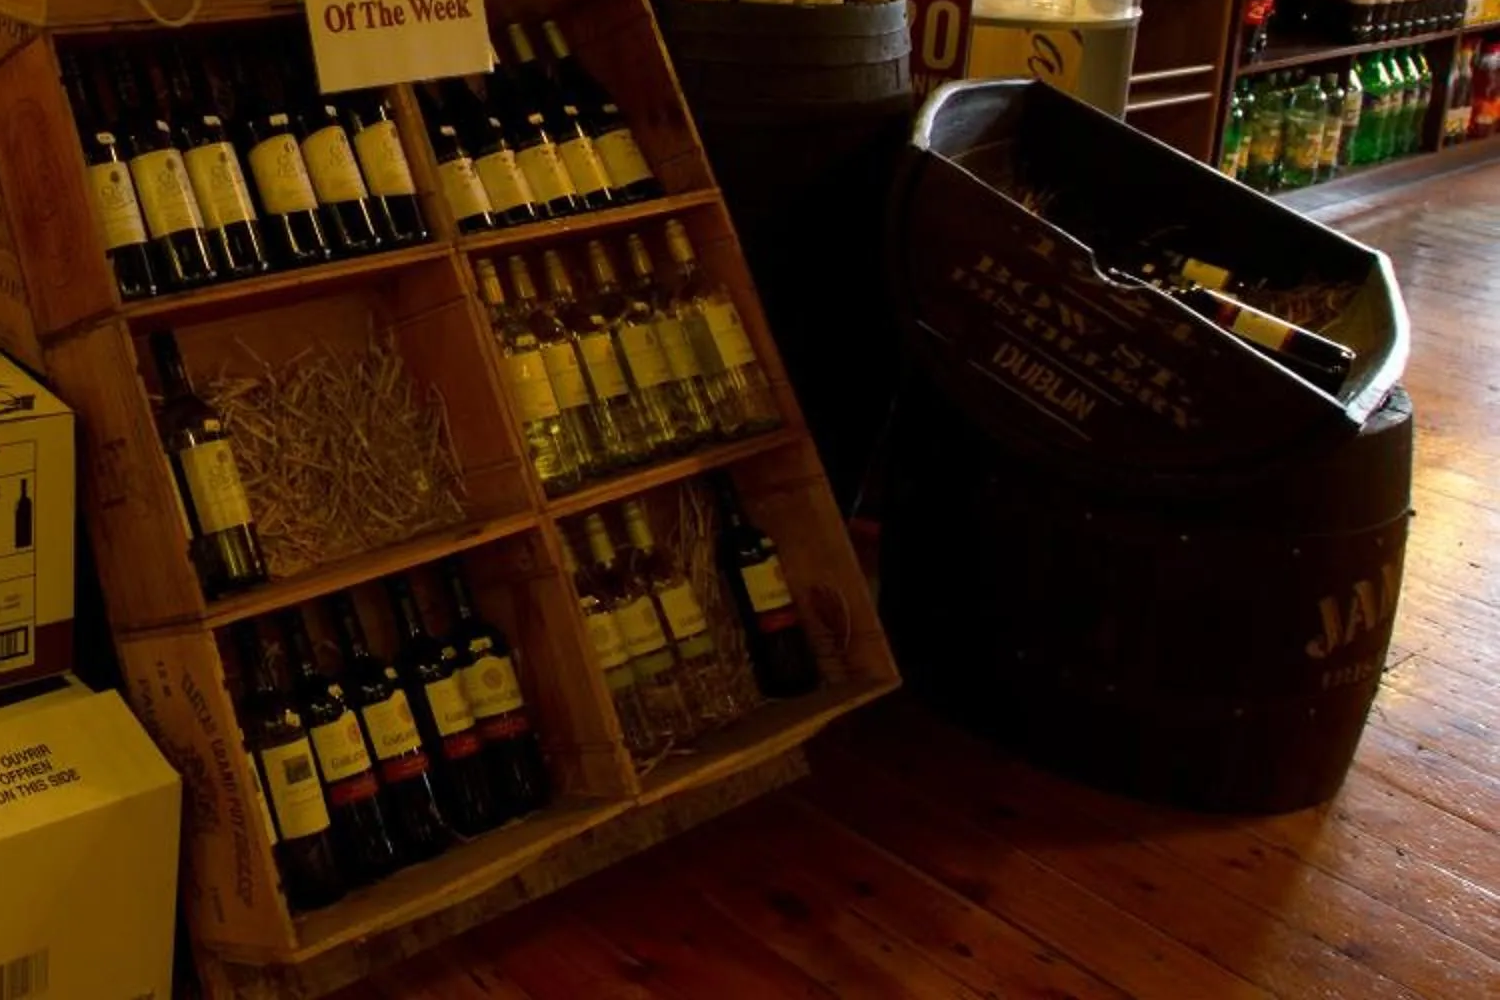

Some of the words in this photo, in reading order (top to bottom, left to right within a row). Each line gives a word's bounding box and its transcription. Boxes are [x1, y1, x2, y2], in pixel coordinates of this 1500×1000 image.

[323, 1, 356, 33] Of
[360, 0, 405, 29] The
[992, 341, 1097, 421] DUBLIN
[0, 743, 53, 769] OUVRIR
[15, 778, 49, 798] THIS
[47, 767, 82, 788] SIDE
